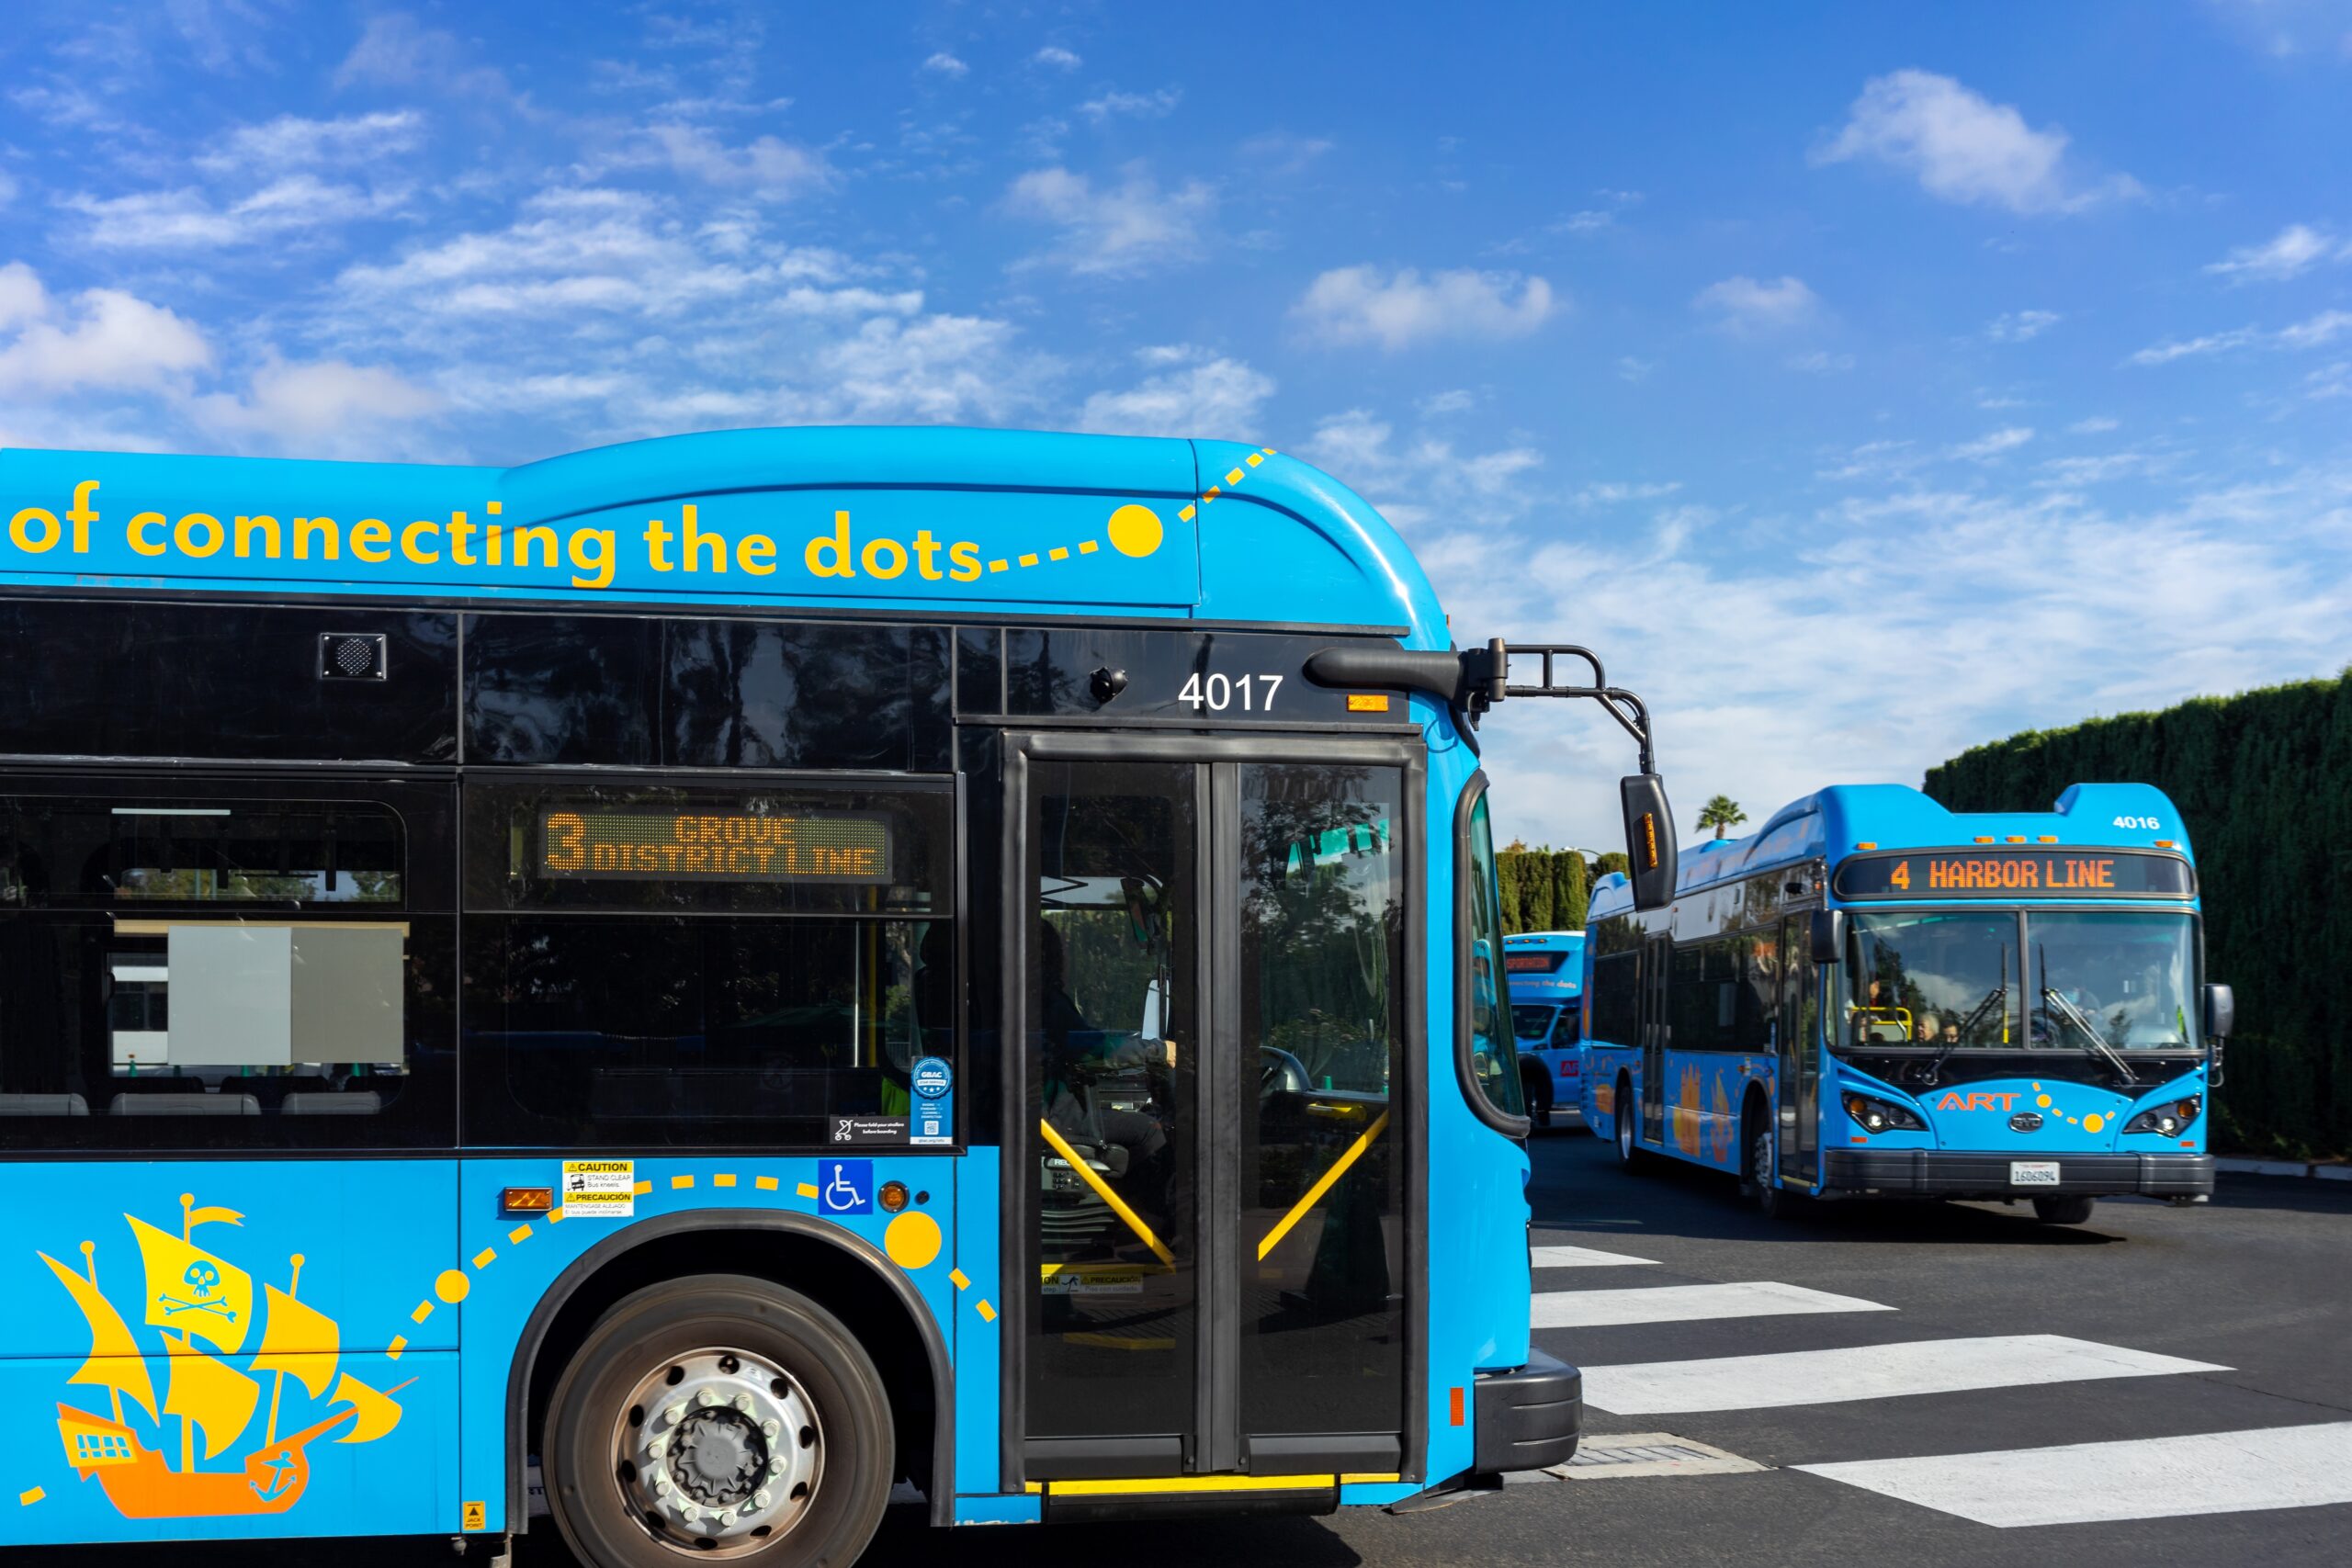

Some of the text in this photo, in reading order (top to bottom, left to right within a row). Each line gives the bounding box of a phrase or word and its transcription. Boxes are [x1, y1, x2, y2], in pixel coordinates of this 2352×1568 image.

[9, 479, 983, 588] of connecting the dots
[1179, 673, 1283, 712] 4017
[675, 815, 796, 844] GROVE
[2112, 815, 2161, 830] 4016
[546, 813, 585, 871] 3
[594, 843, 876, 875] DISTRICT LINE
[1890, 859, 2116, 890] 4 HARBOR LINE
[1937, 1092, 2021, 1111] ART
[578, 1163, 628, 1172] CAUTION
[576, 1192, 631, 1201] PRECAUCIÓN
